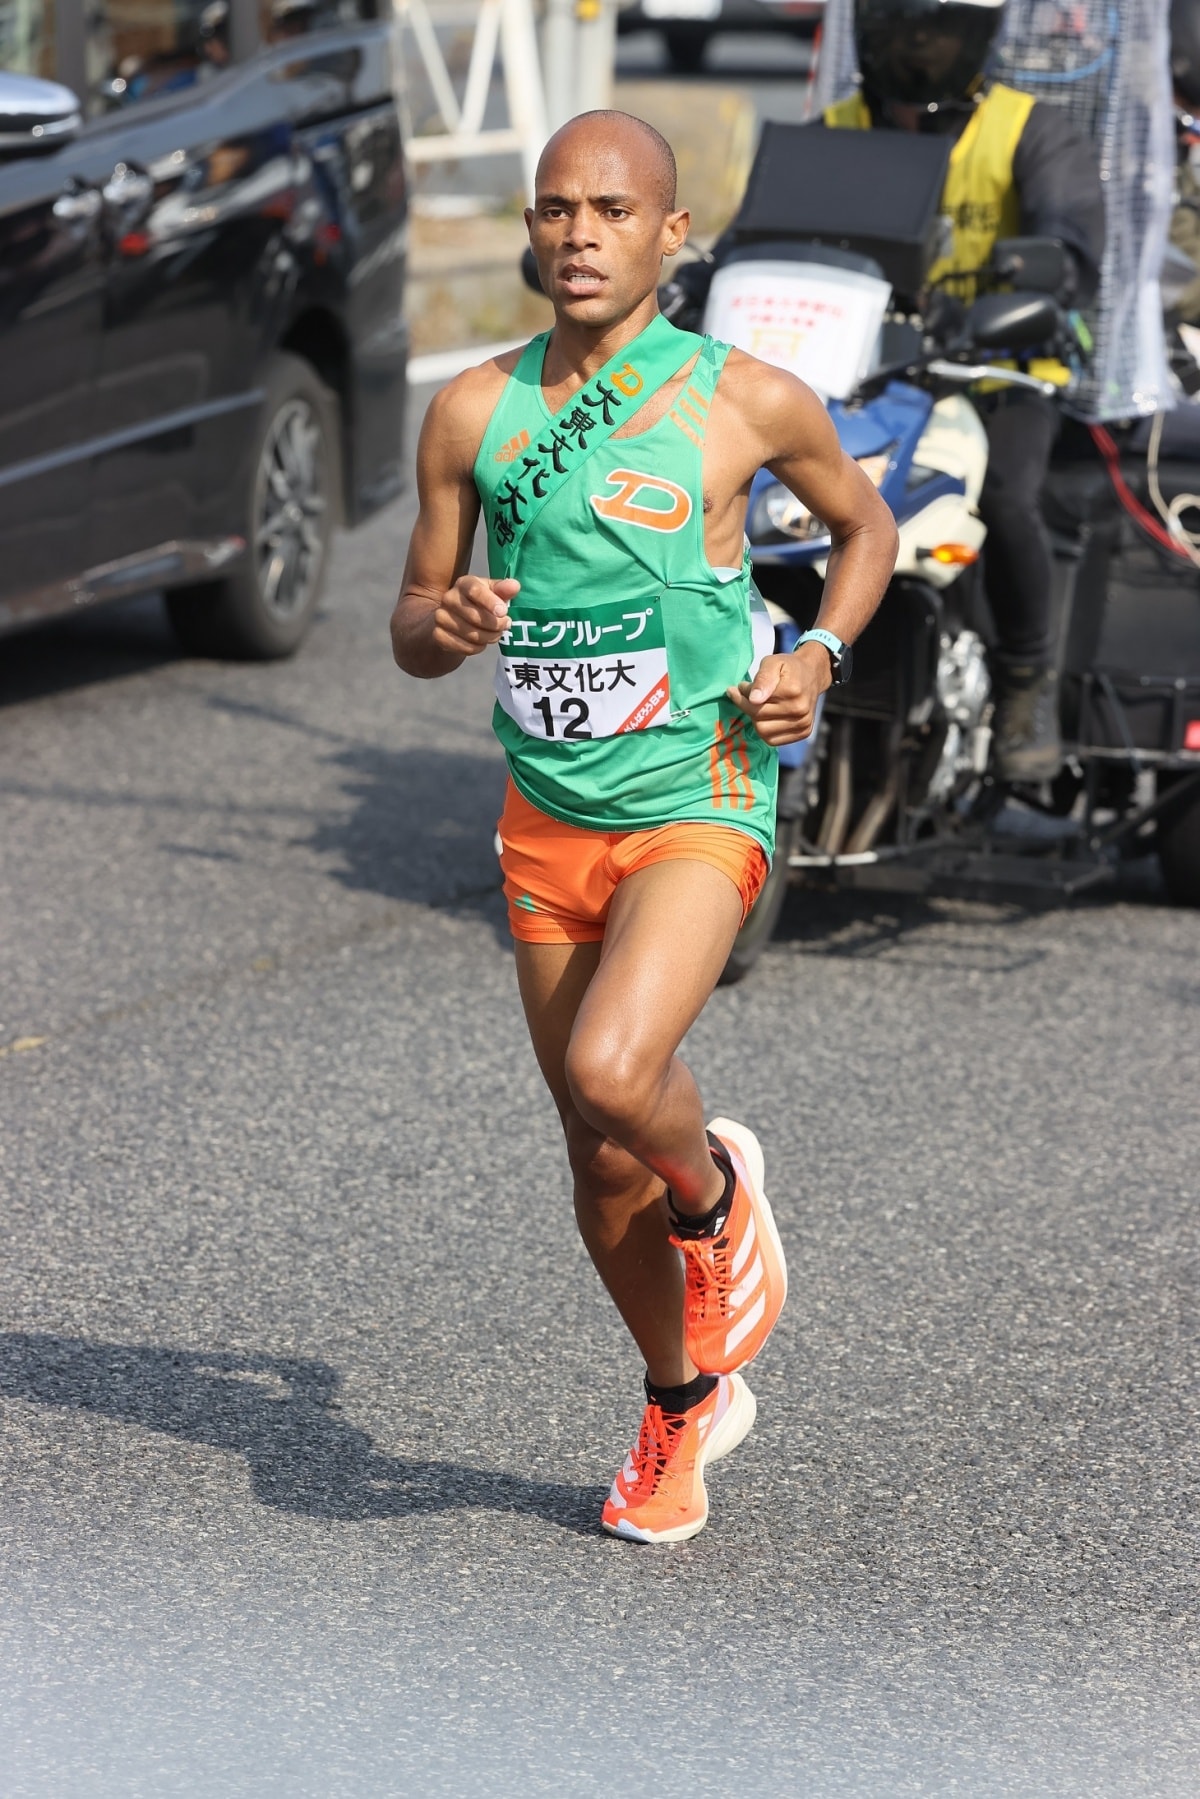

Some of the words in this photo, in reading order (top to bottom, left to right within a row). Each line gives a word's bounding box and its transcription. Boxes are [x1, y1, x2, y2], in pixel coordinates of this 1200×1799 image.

[589, 467, 692, 533] D
[498, 608, 653, 647] 工グループ
[504, 659, 636, 693] 東文化大
[533, 696, 592, 739] 12
